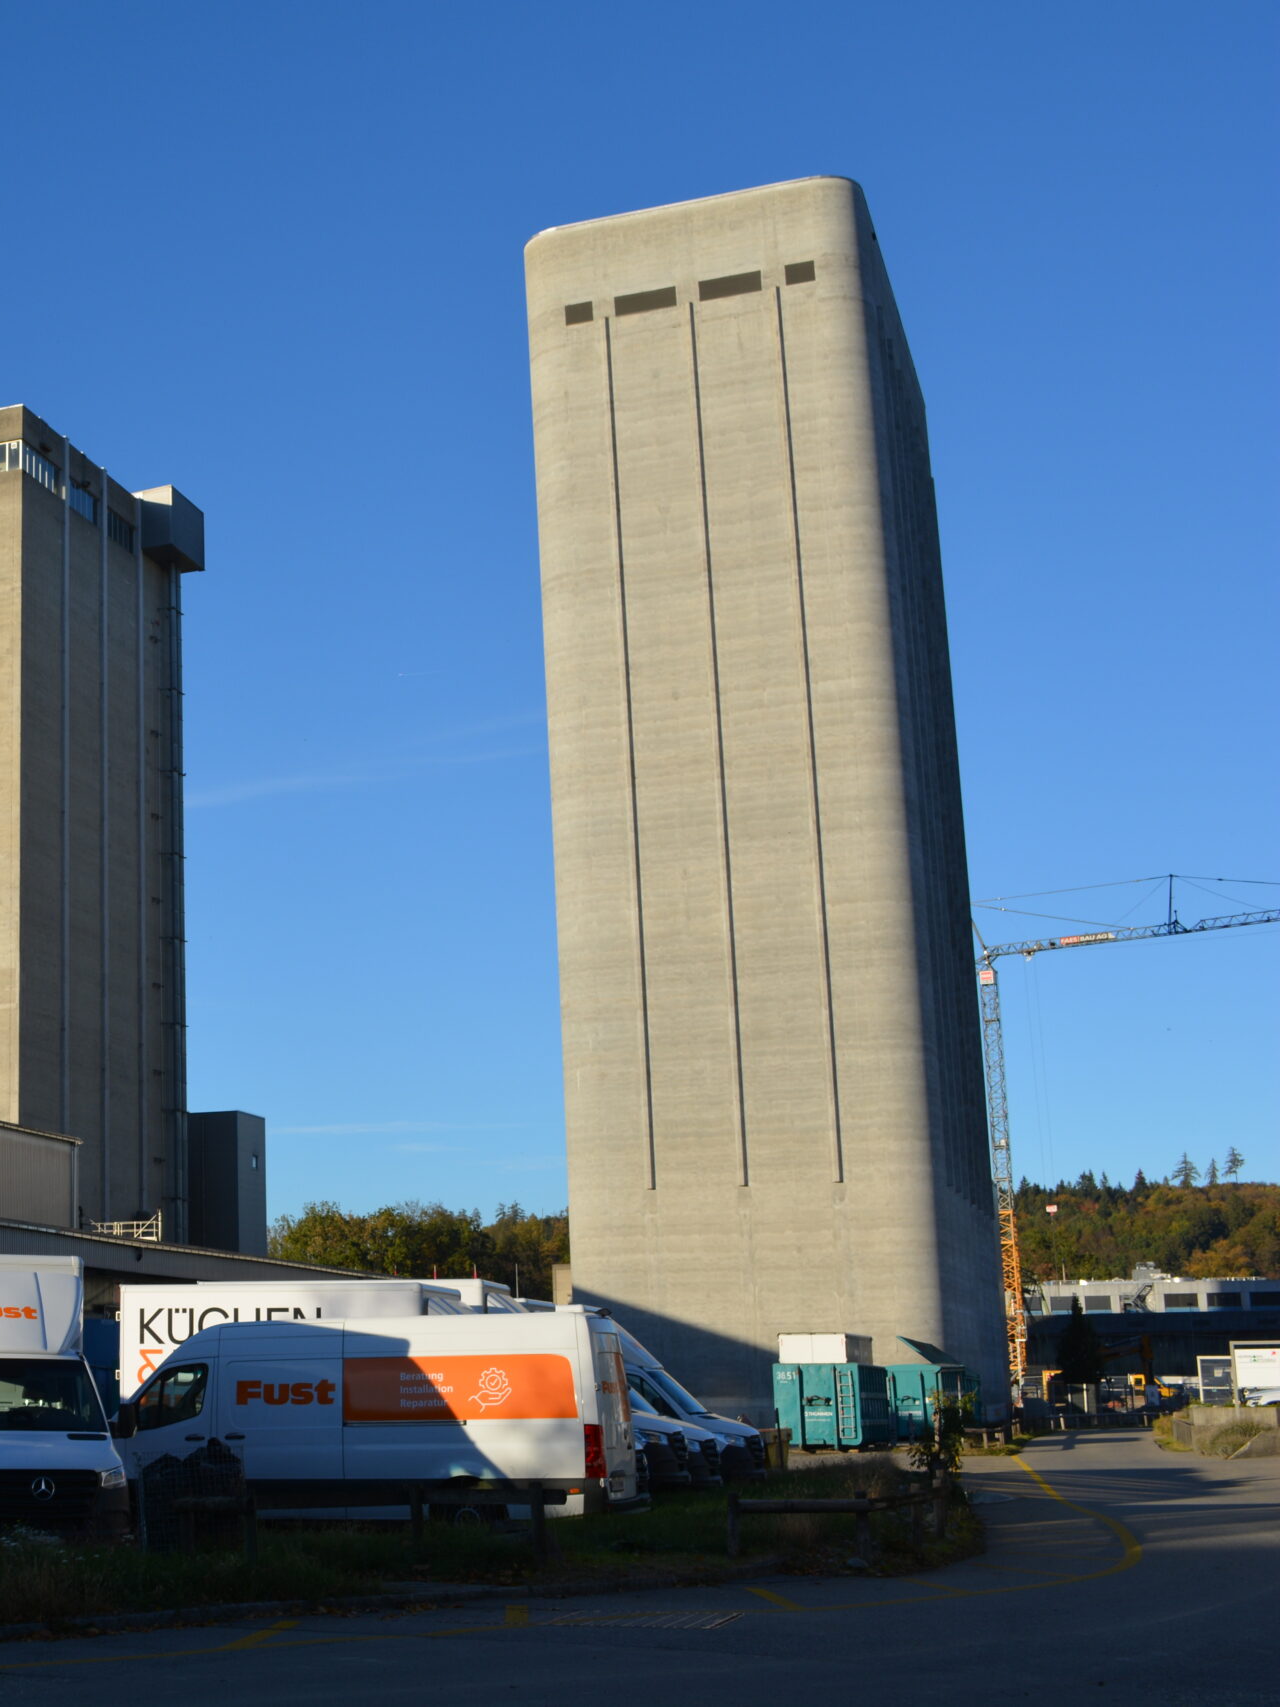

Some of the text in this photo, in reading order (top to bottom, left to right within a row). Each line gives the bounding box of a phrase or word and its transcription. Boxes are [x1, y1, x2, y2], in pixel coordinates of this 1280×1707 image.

[400, 1372, 444, 1382] Beratung
[236, 1379, 336, 1405] Fust
[400, 1384, 454, 1394] Installation
[400, 1398, 447, 1409] Reparatur
